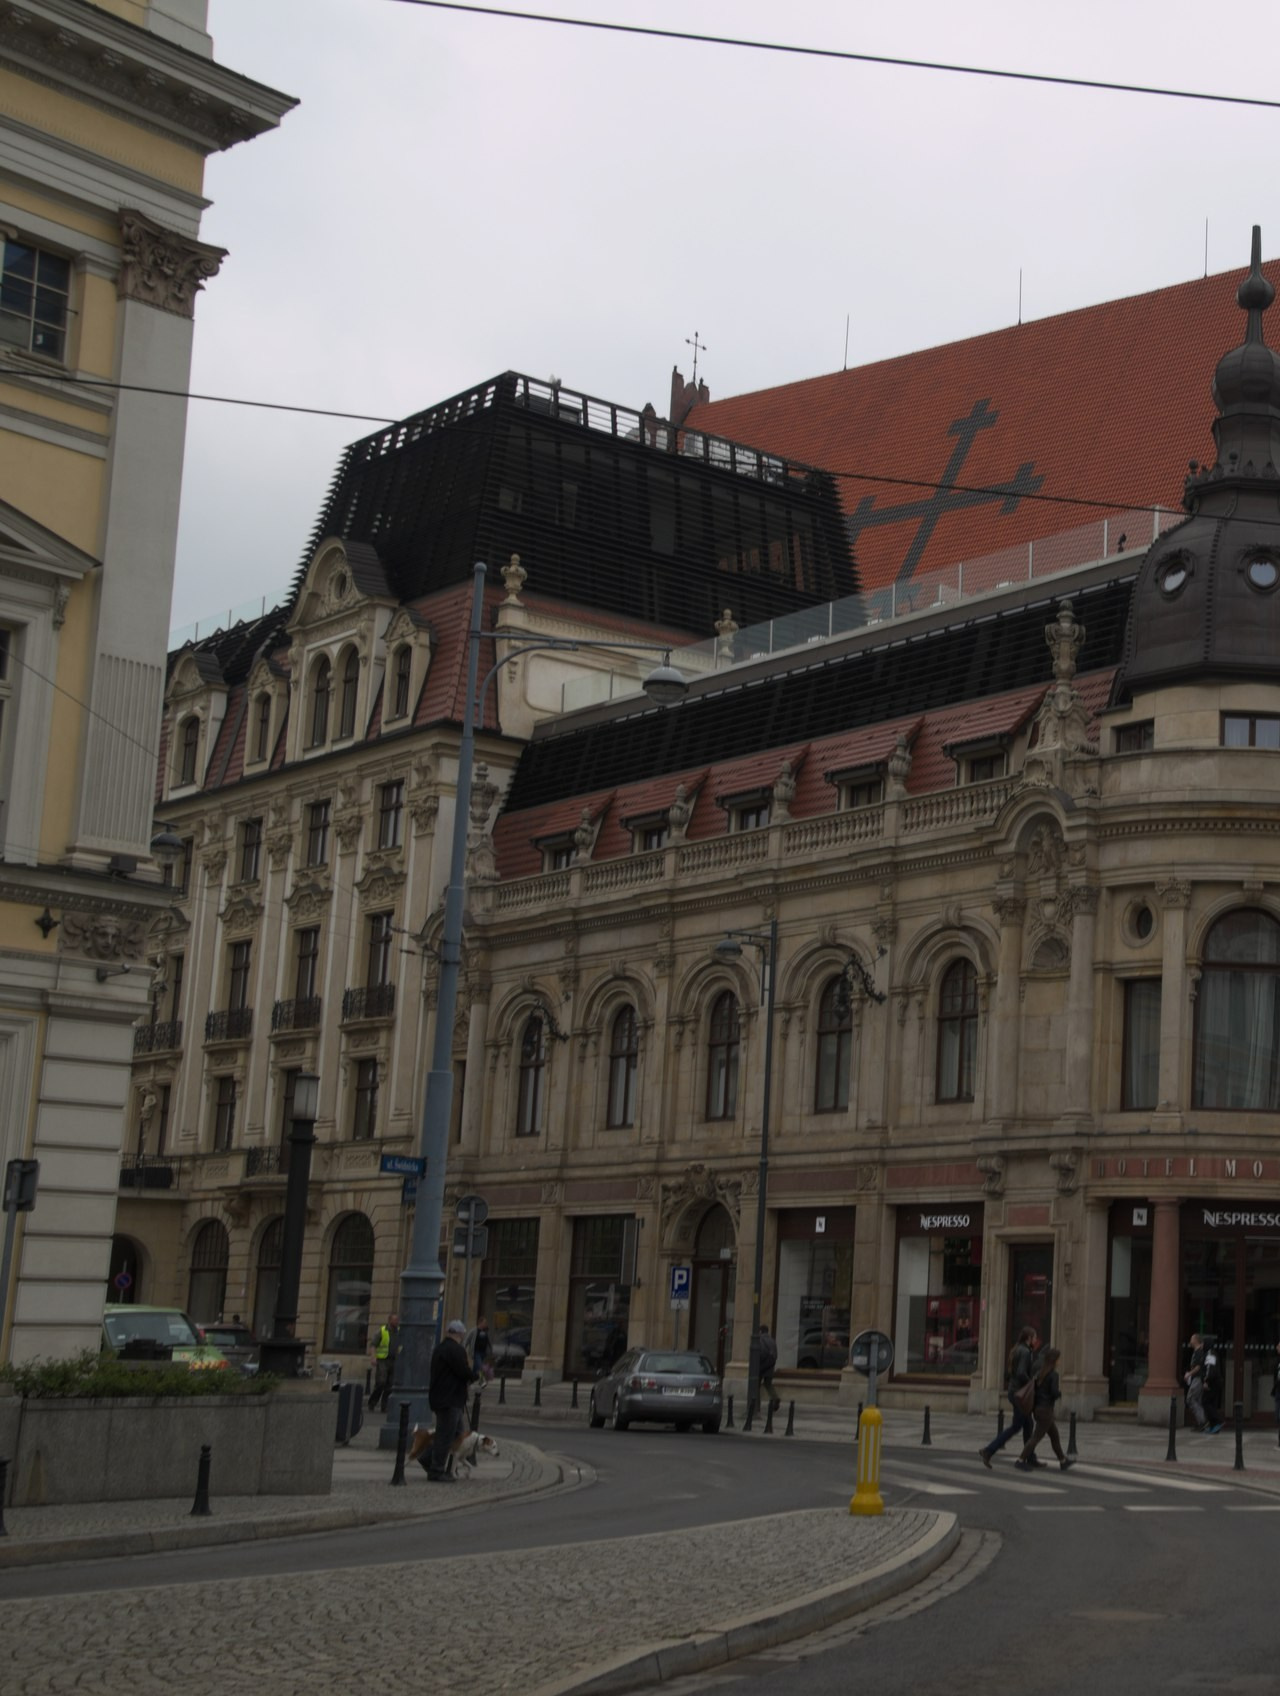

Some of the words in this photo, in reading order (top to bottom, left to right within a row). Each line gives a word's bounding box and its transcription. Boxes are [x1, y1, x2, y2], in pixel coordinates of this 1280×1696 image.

[1097, 1157, 1197, 1177] HOTEL
[919, 1213, 970, 1231] NESPRESSO
[674, 1269, 688, 1291] P
